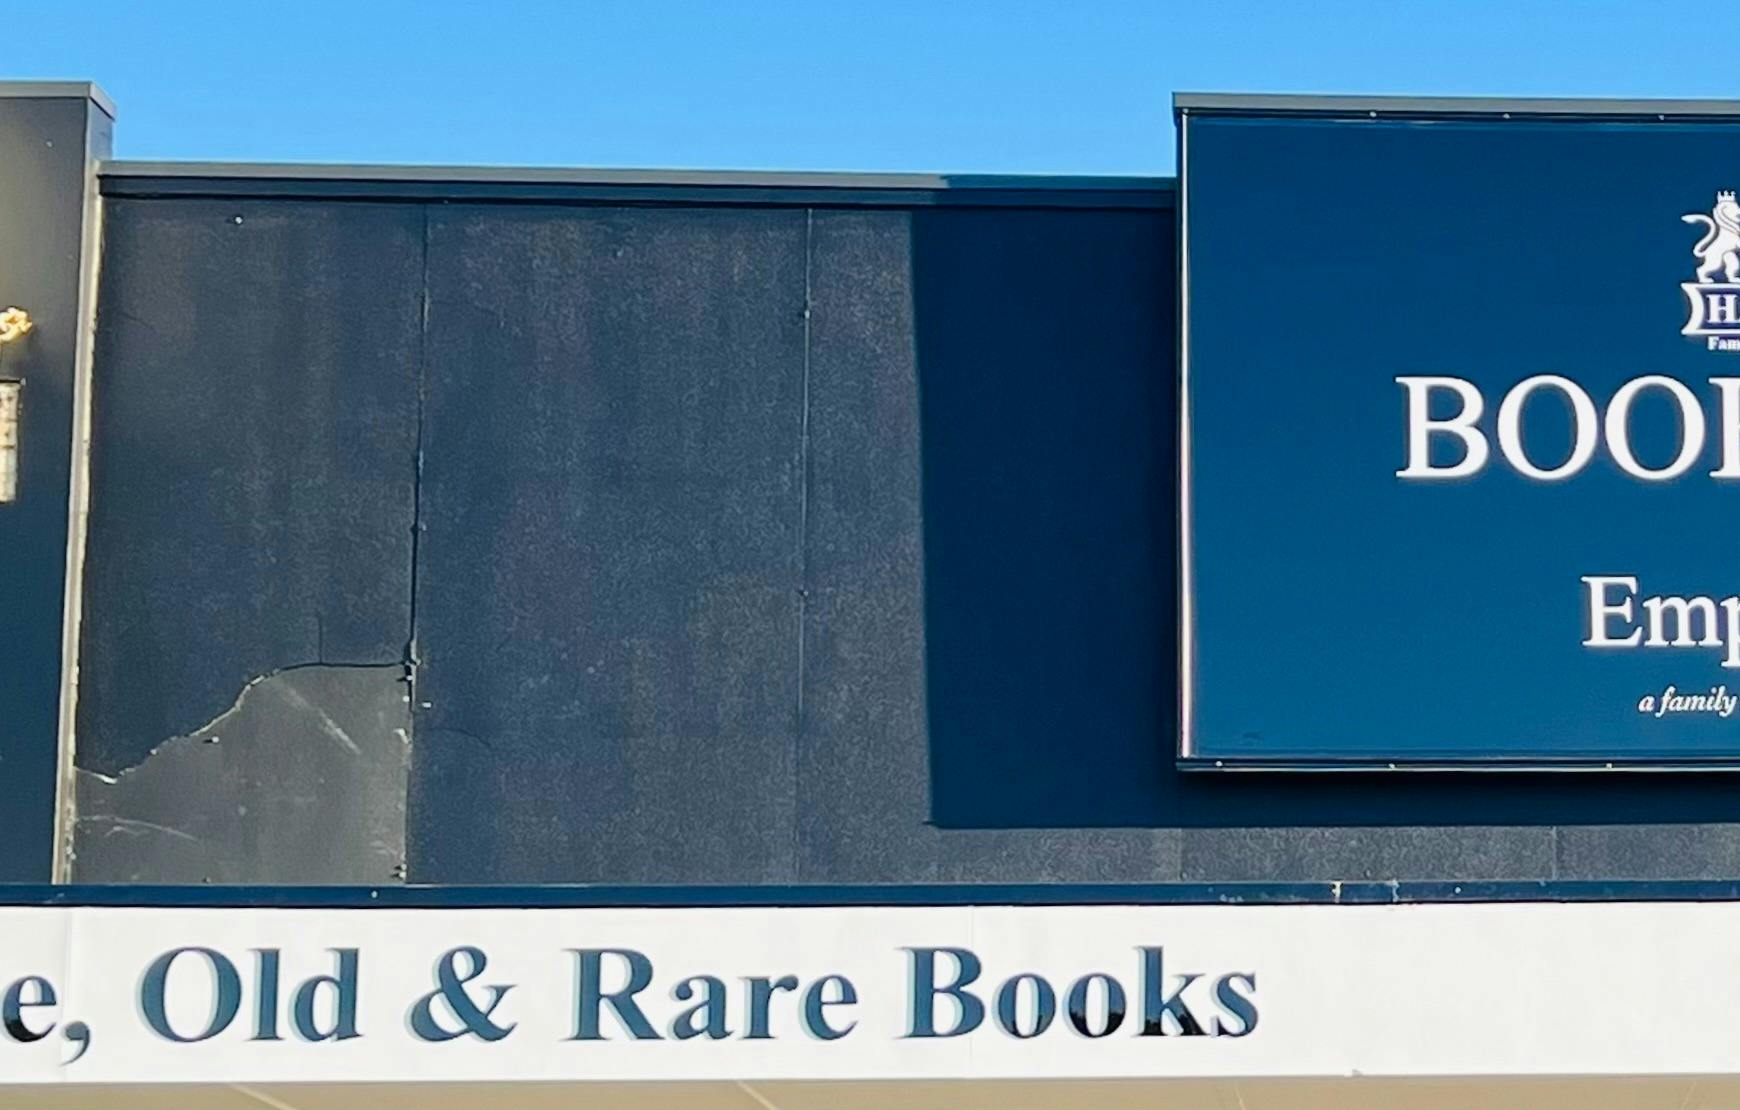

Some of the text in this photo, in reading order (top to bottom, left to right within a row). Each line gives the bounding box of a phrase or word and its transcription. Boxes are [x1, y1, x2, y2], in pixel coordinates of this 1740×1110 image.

[1638, 695, 1654, 713] a
[1655, 685, 1737, 718] family
[136, 946, 364, 1043] Old
[407, 945, 519, 1043] &
[563, 947, 859, 1042] Rare
[899, 945, 1259, 1040] Books
